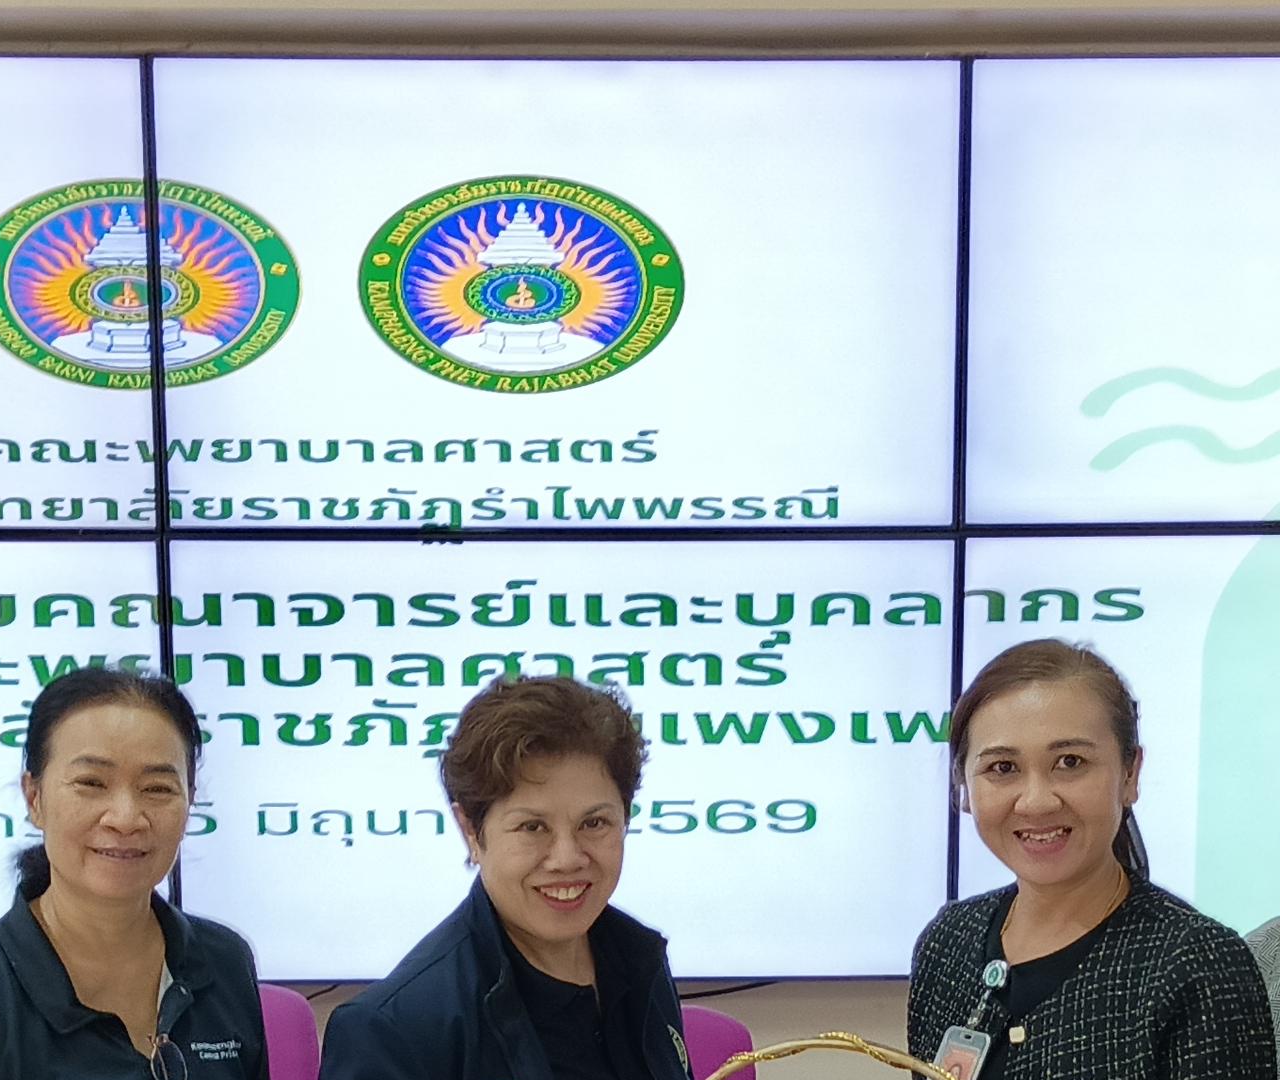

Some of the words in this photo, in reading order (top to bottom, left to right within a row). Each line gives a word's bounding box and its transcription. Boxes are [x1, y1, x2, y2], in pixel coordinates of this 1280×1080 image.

[430, 357, 491, 387] PHET
[495, 357, 617, 393] RAJABHAT
[612, 286, 676, 363] UNIVERSITY
